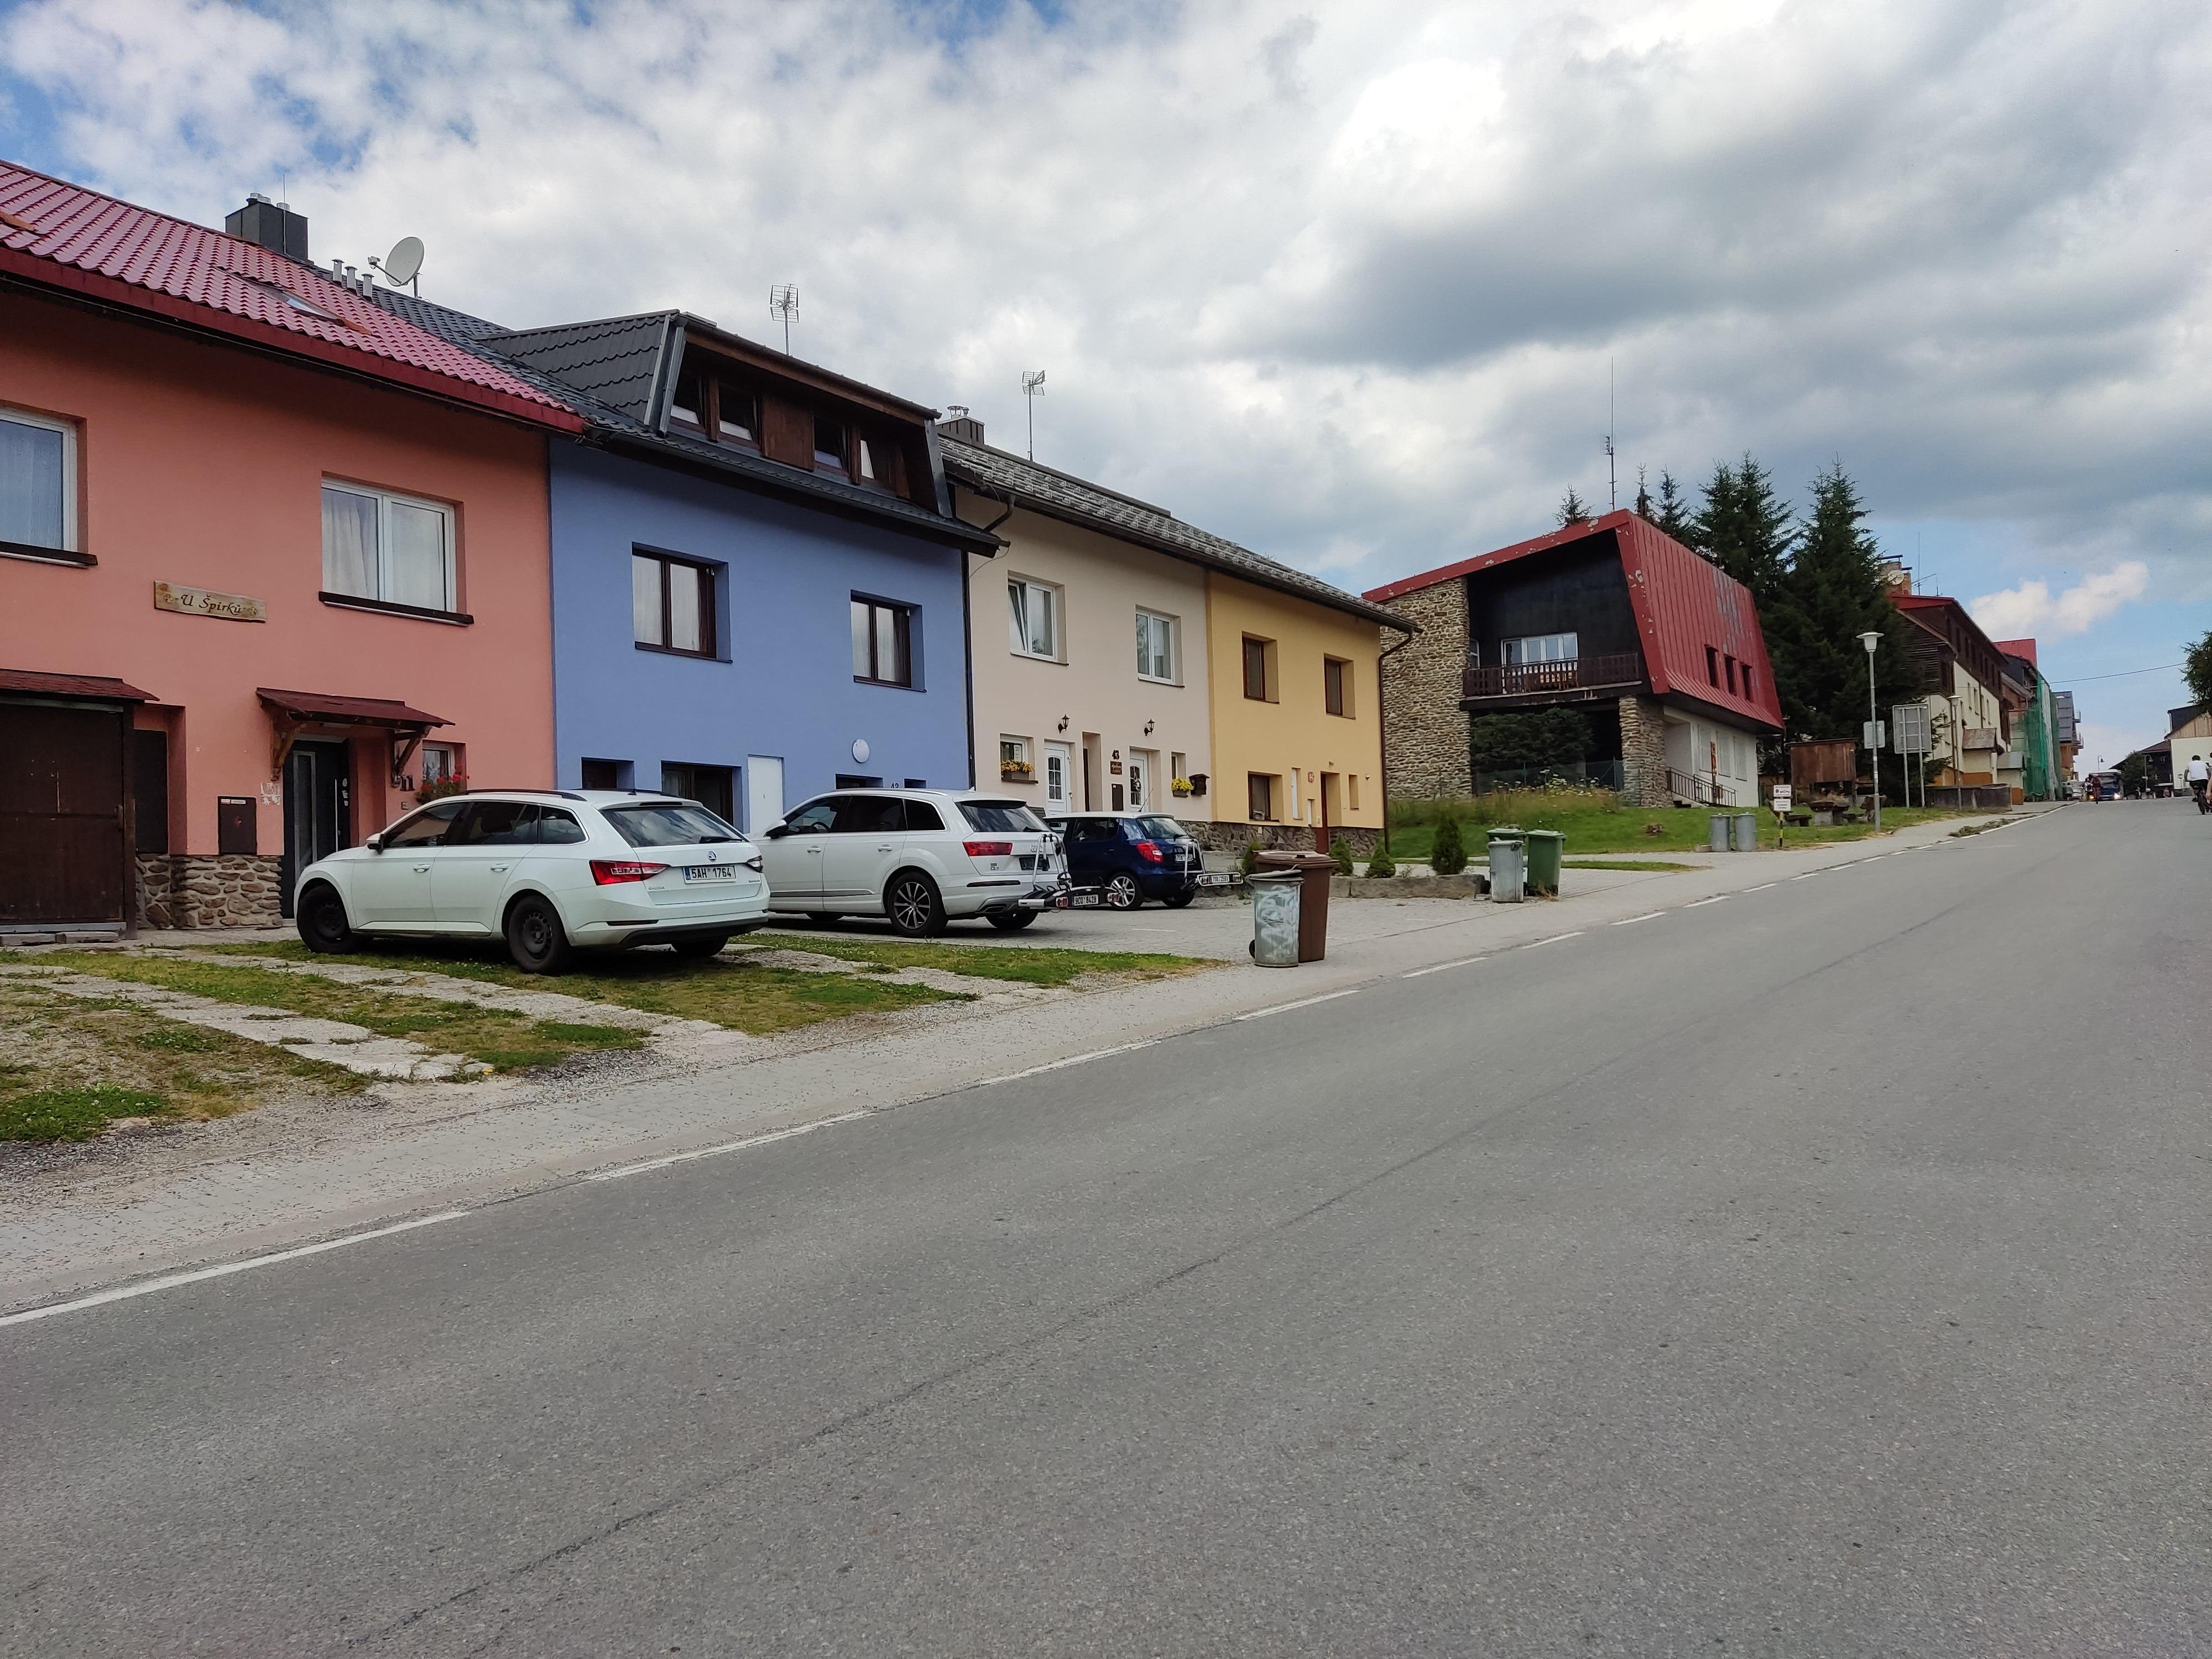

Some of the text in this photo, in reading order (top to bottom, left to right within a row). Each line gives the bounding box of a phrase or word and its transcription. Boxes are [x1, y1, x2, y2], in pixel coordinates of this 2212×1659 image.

[1112, 749, 1120, 760] 43
[691, 867, 732, 878] 5AH 1764
